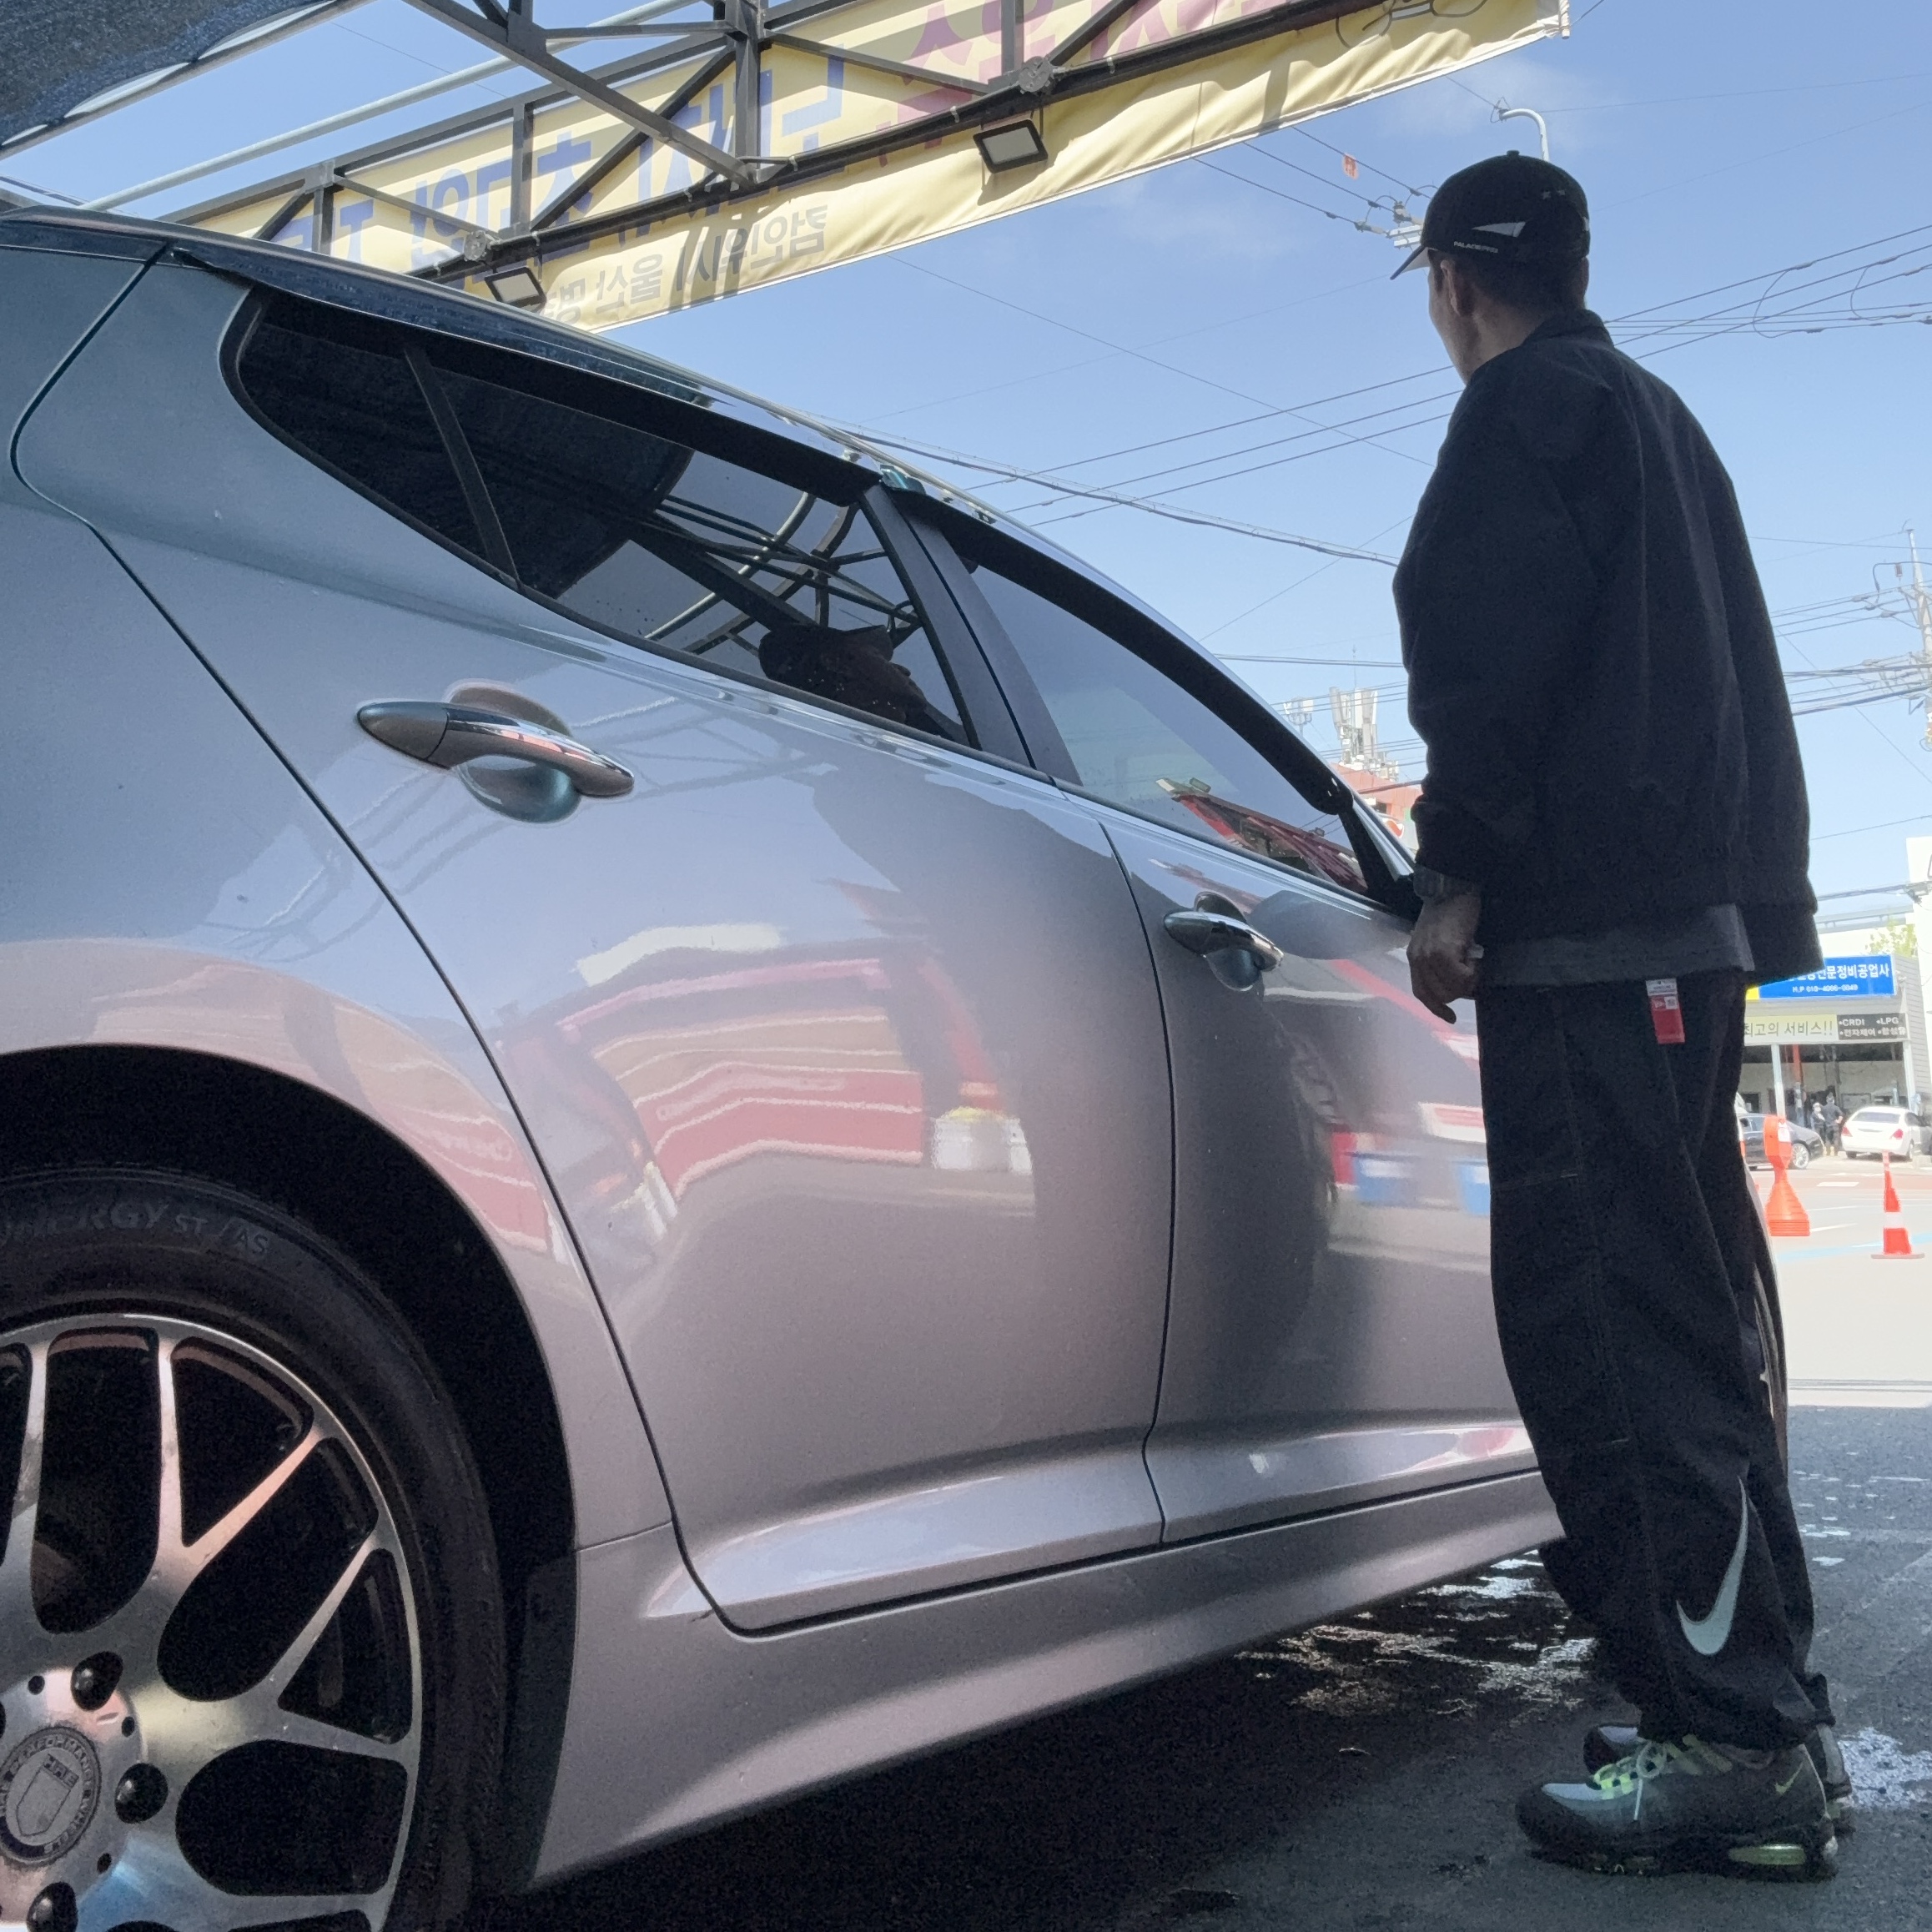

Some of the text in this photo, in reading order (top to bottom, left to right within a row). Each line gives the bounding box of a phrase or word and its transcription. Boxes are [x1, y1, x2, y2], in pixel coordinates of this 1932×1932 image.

[1880, 1017, 1899, 1025] LPG
[1744, 1021, 1833, 1037] 최고의 서비스!!
